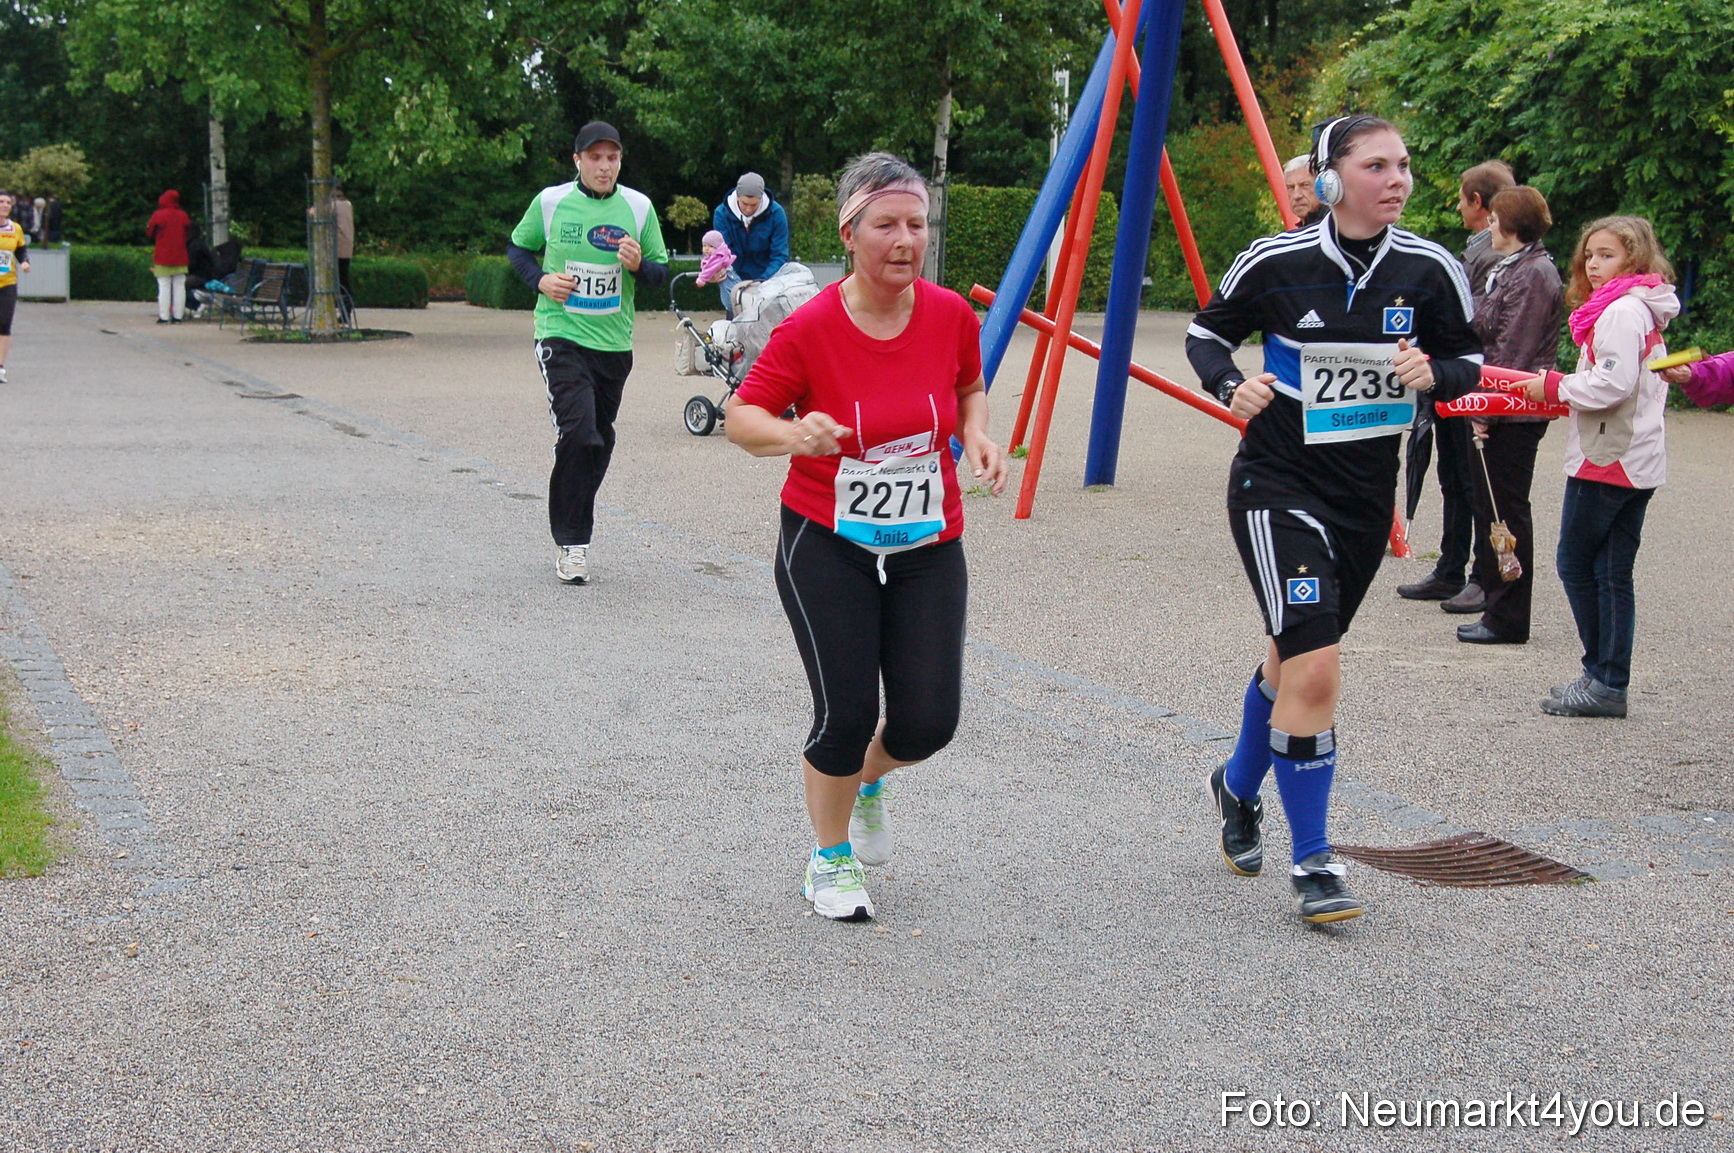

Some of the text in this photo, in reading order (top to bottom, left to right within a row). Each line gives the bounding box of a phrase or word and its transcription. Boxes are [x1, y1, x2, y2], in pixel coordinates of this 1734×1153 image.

[566, 265, 585, 273] PARTL
[571, 274, 617, 296] 2154
[574, 298, 611, 308] Sebastian
[1296, 321, 1325, 329] adidas
[1303, 354, 1394, 367] PARTL Neumark
[1314, 367, 1405, 403] 2239
[1331, 408, 1389, 428] Stefanie
[884, 441, 914, 454] DEHN
[878, 463, 926, 475] Neumarkt
[848, 478, 931, 519] 2271
[873, 529, 909, 545] Anita
[1294, 756, 1335, 773] HSV
